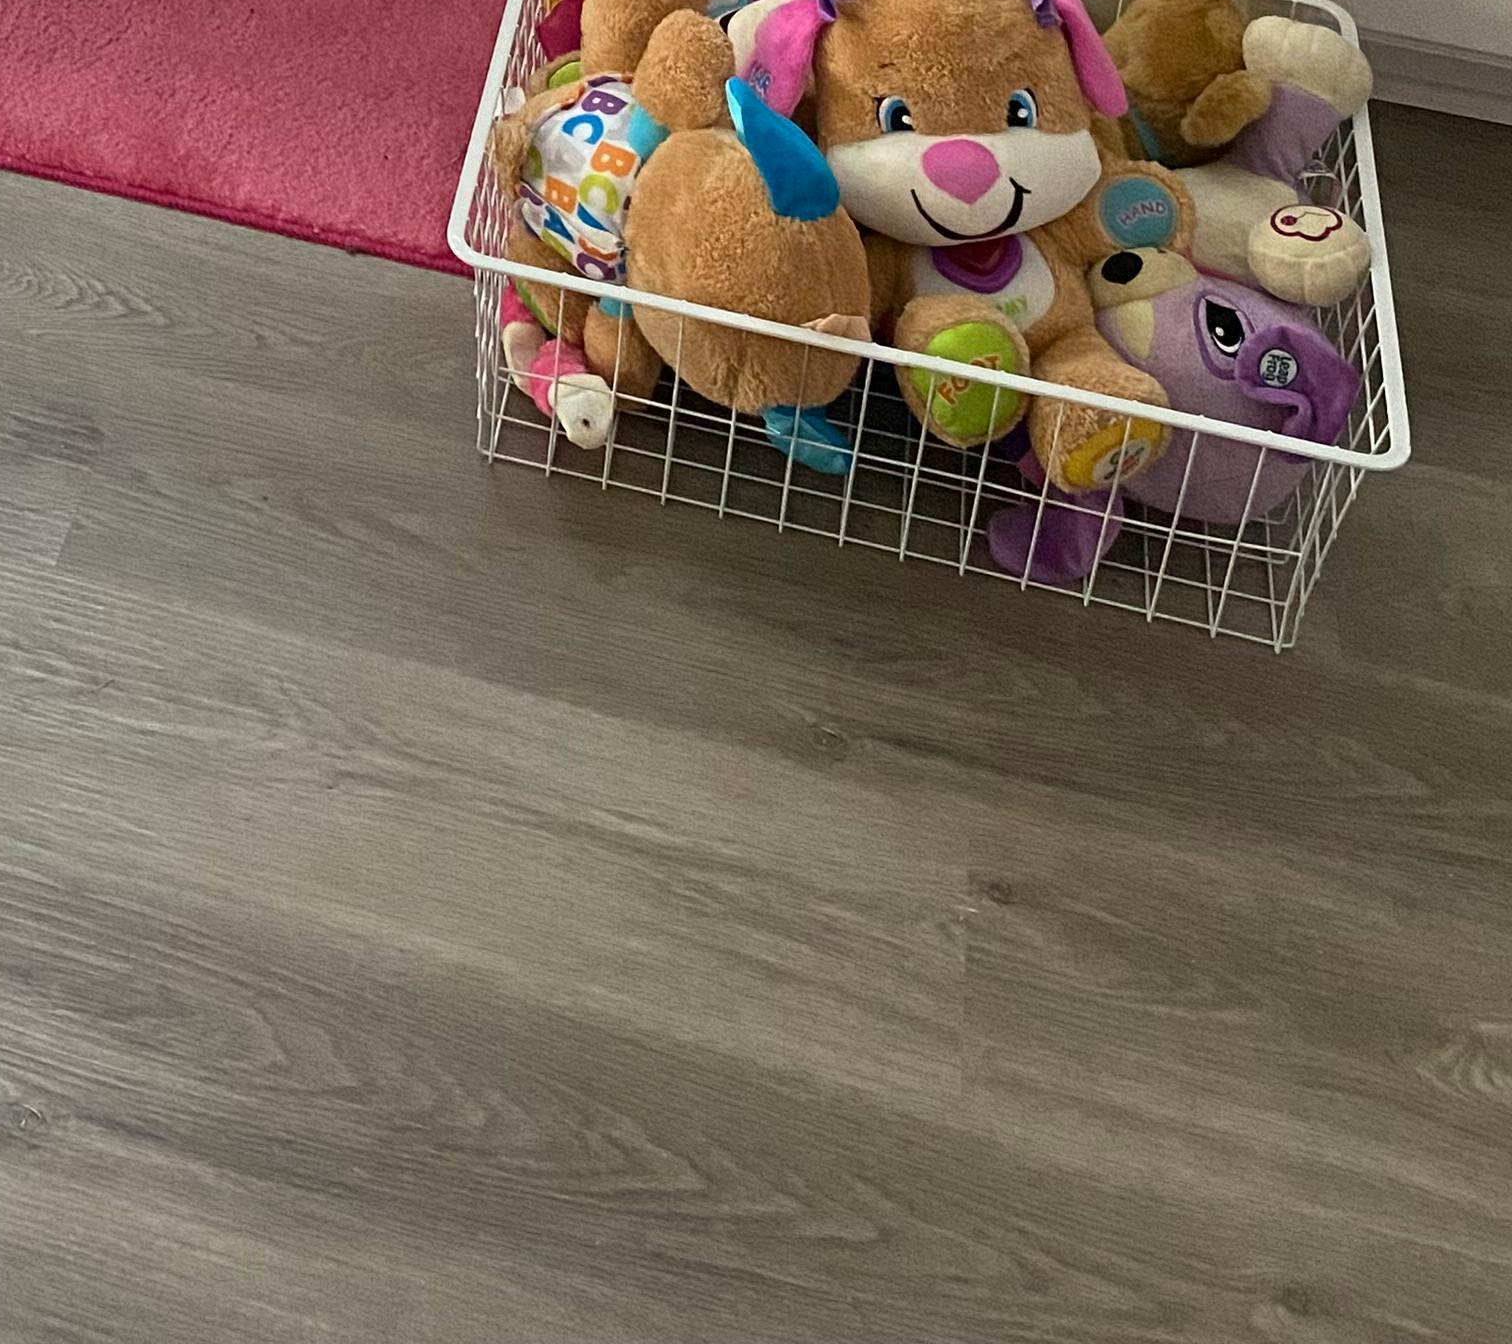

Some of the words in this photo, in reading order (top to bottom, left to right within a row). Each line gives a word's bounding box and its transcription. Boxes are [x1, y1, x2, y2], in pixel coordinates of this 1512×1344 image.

[1117, 201, 1168, 227] HAND
[1261, 353, 1281, 382] Frog
[1276, 356, 1293, 385] Leap
